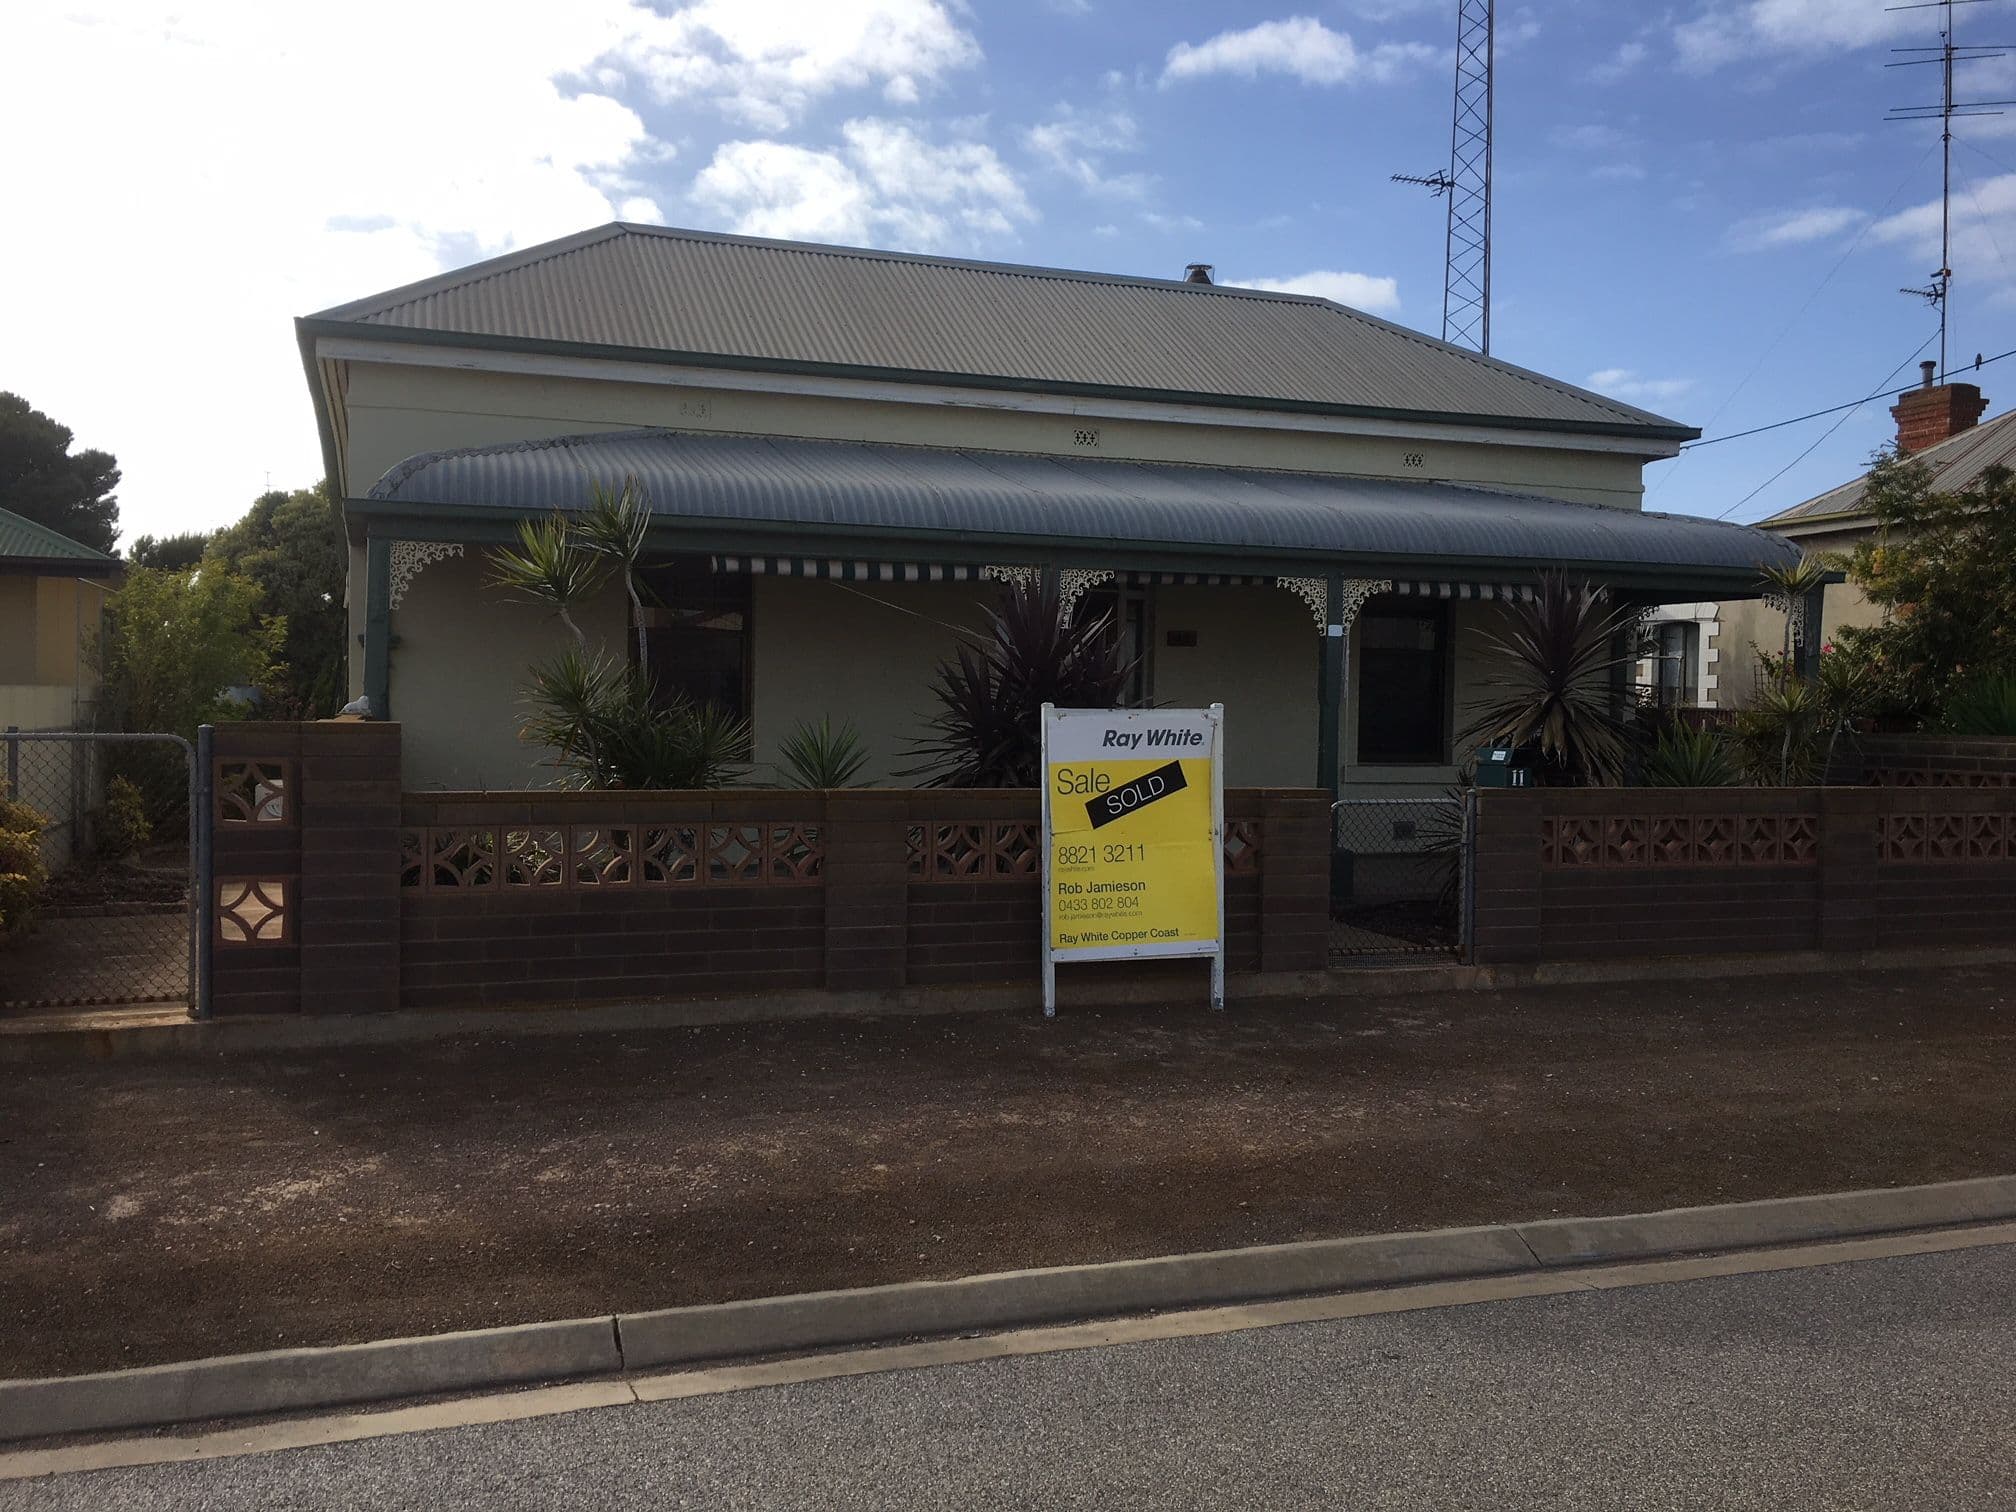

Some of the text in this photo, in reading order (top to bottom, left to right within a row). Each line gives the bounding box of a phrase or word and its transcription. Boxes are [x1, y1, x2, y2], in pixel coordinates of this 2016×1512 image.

[1102, 729, 1203, 750] Ray White
[1057, 768, 1110, 795] Sale
[1512, 769, 1524, 787] 11
[1106, 775, 1165, 815] SOLD
[1058, 844, 1144, 864] 8821 3211
[1059, 881, 1146, 895] Rob Jamieson
[1058, 896, 1139, 911] 0433 802 804
[1059, 927, 1179, 944] Ray White Copper Coast
